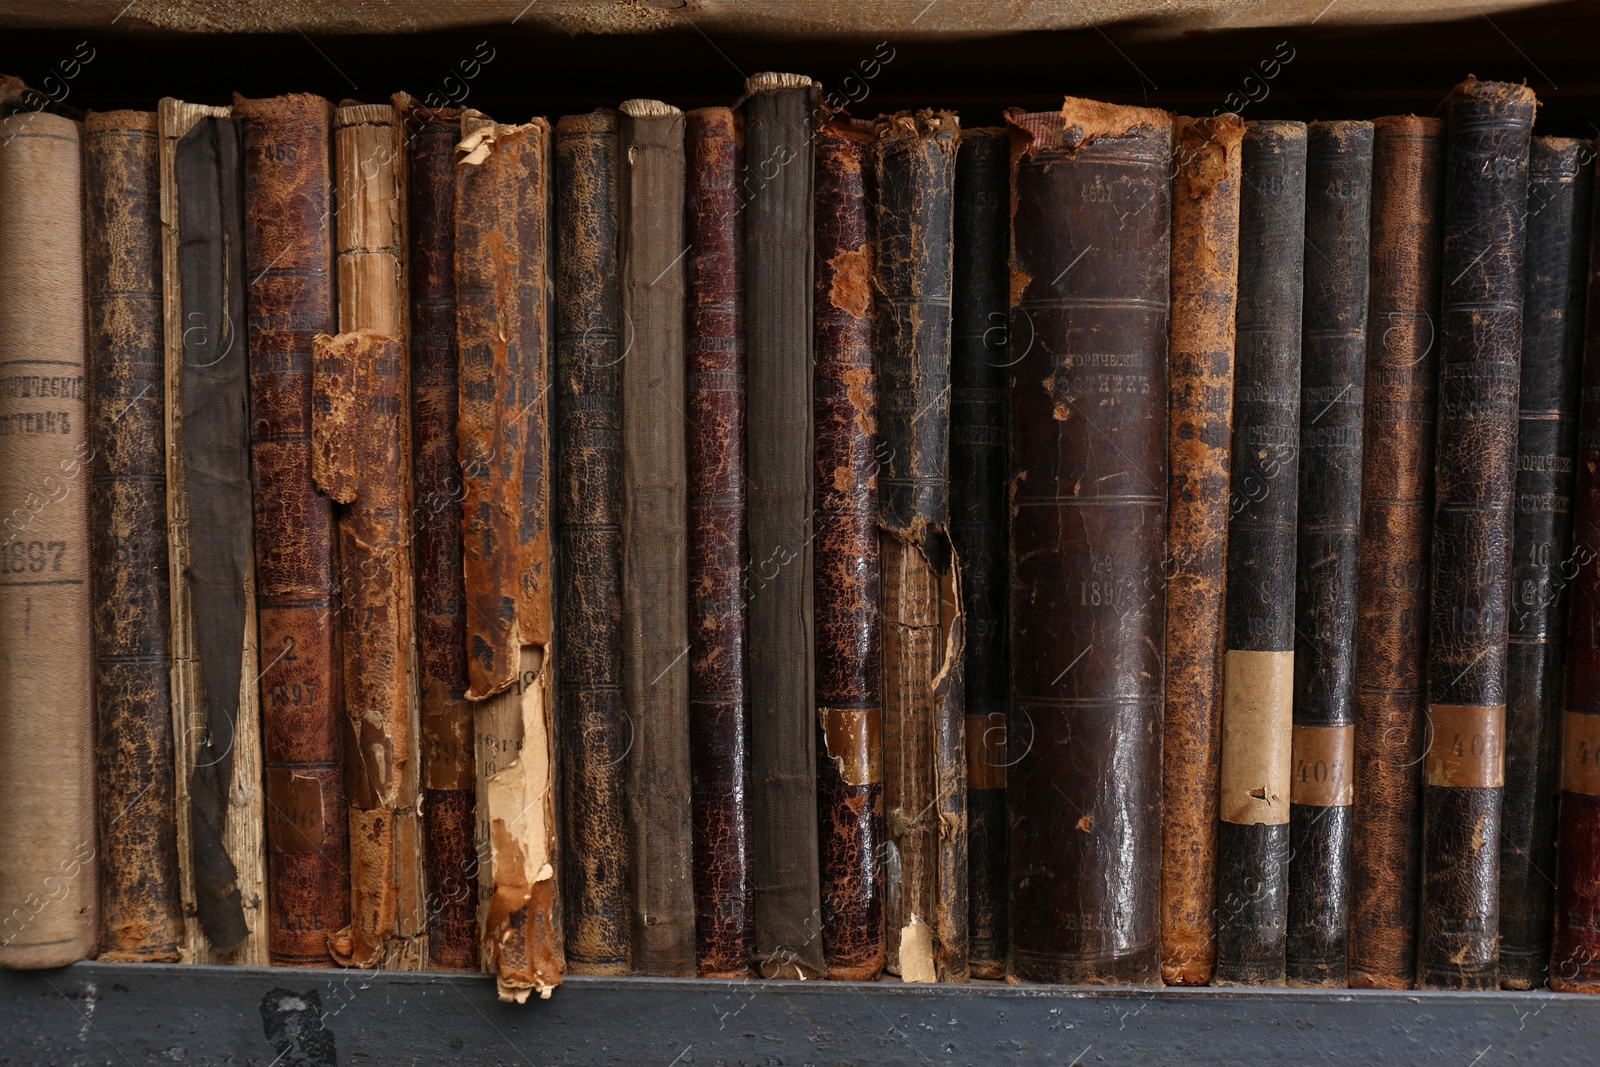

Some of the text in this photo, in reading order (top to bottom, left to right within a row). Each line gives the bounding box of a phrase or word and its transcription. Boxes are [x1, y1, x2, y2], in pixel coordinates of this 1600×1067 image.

[1, 541, 66, 573] 1897
[845, 554, 856, 577] 6
[1081, 579, 1126, 607] 1897
[829, 606, 875, 626] 1897
[283, 634, 298, 660] 2
